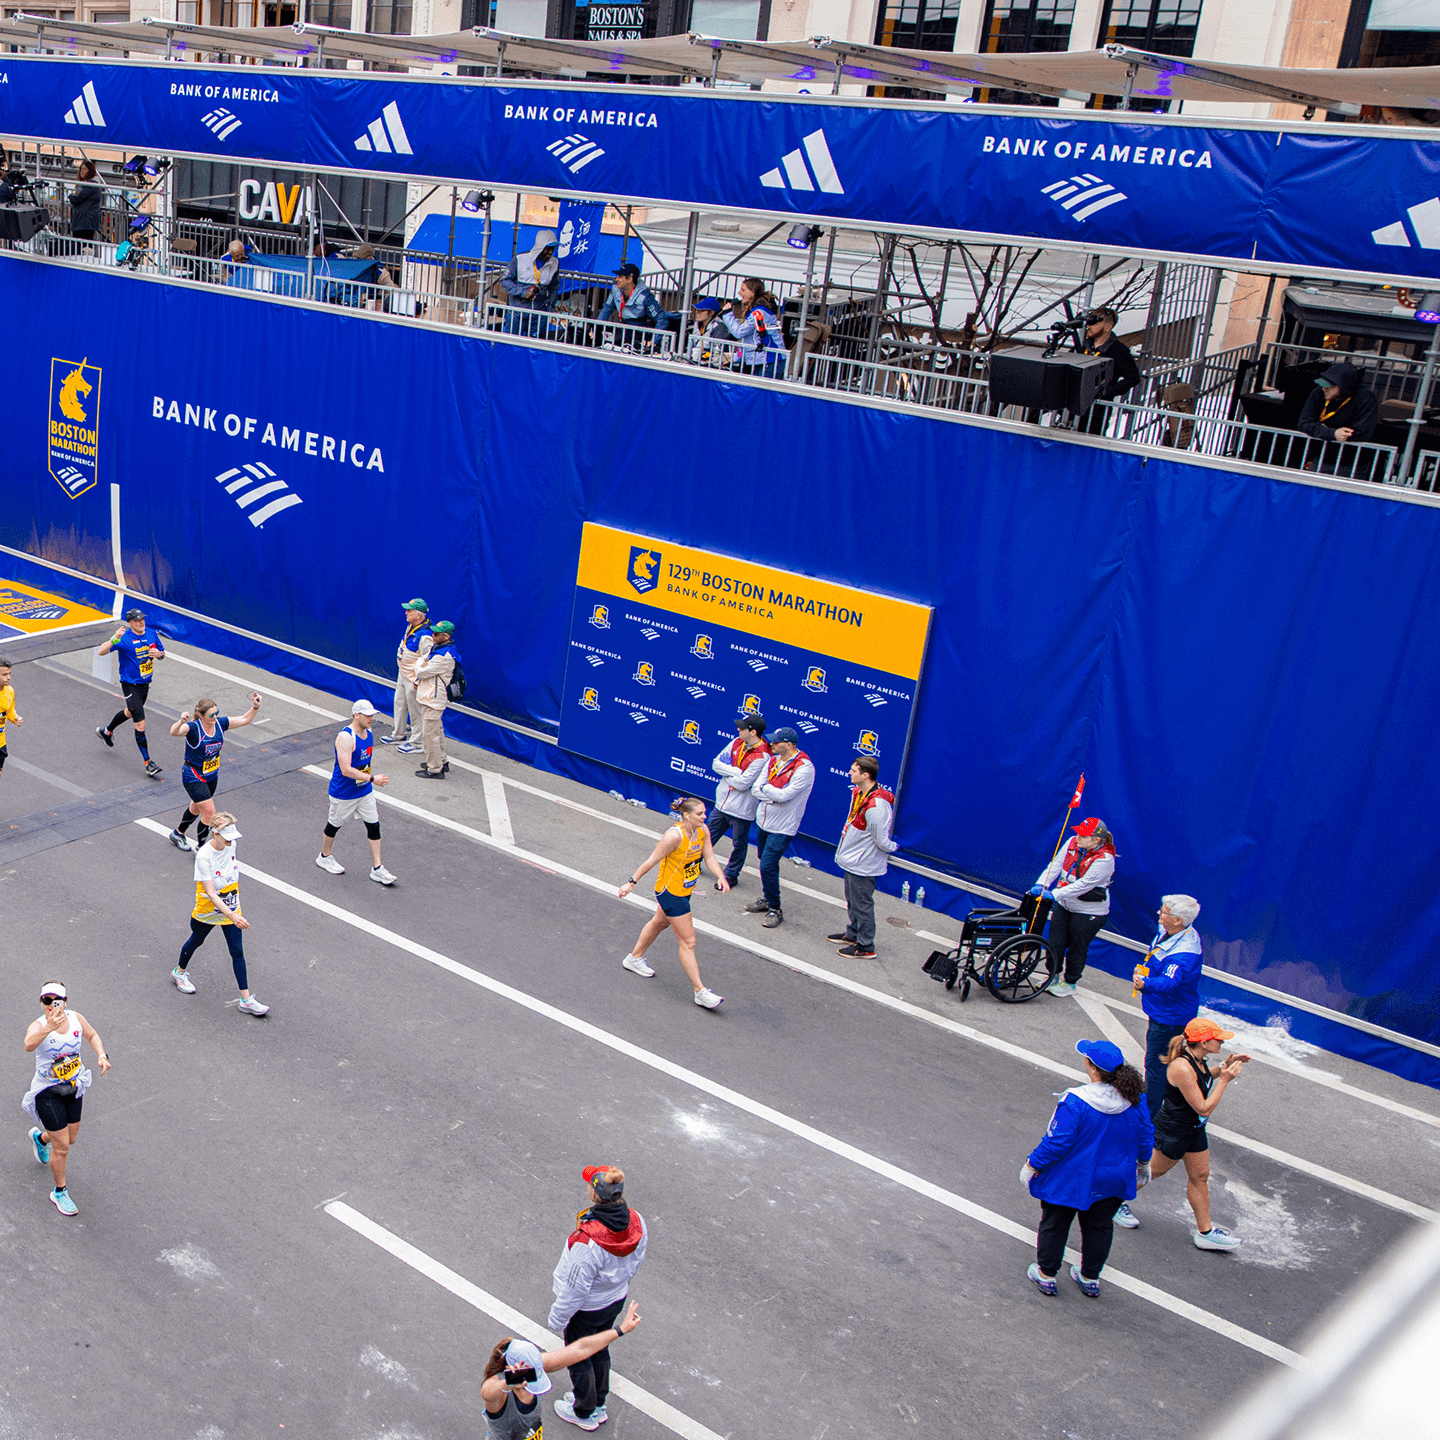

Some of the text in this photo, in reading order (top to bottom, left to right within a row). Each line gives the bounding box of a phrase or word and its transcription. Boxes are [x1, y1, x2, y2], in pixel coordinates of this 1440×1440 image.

[588, 6, 645, 26] BOSTON'S
[588, 30, 642, 40] NAILS & SPA
[170, 83, 279, 102] BANK OF AMERICA
[504, 104, 658, 128] BANK OF AMERICA
[982, 136, 1212, 168] BANK OF AMERICA
[240, 178, 317, 227] CAVA
[51, 420, 96, 444] BOSTON
[152, 396, 384, 473] BANK OF AMERICA
[51, 436, 96, 456] MARATHON
[667, 583, 774, 620] BANK OF AMERICA
[668, 563, 863, 628] 129TH BOSTON MARATHON
[625, 613, 641, 623] BANK
[651, 620, 678, 633] AMERICA
[571, 640, 587, 650] BANK
[596, 648, 621, 660] AMERICA
[730, 644, 748, 653] BANK
[759, 651, 789, 665] AMERICA
[671, 671, 688, 681] BANK
[697, 679, 725, 692] AMERICA
[846, 677, 865, 687] BANK
[877, 685, 910, 700] AMERICA
[614, 697, 630, 706] BANK
[640, 705, 666, 718] AMERICA
[779, 704, 798, 714] BANK
[809, 713, 840, 727] AMERICA
[717, 730, 735, 740] BANK
[686, 768, 704, 777] WORLD
[687, 764, 706, 773] ABBOTT
[830, 767, 849, 778] BANK
